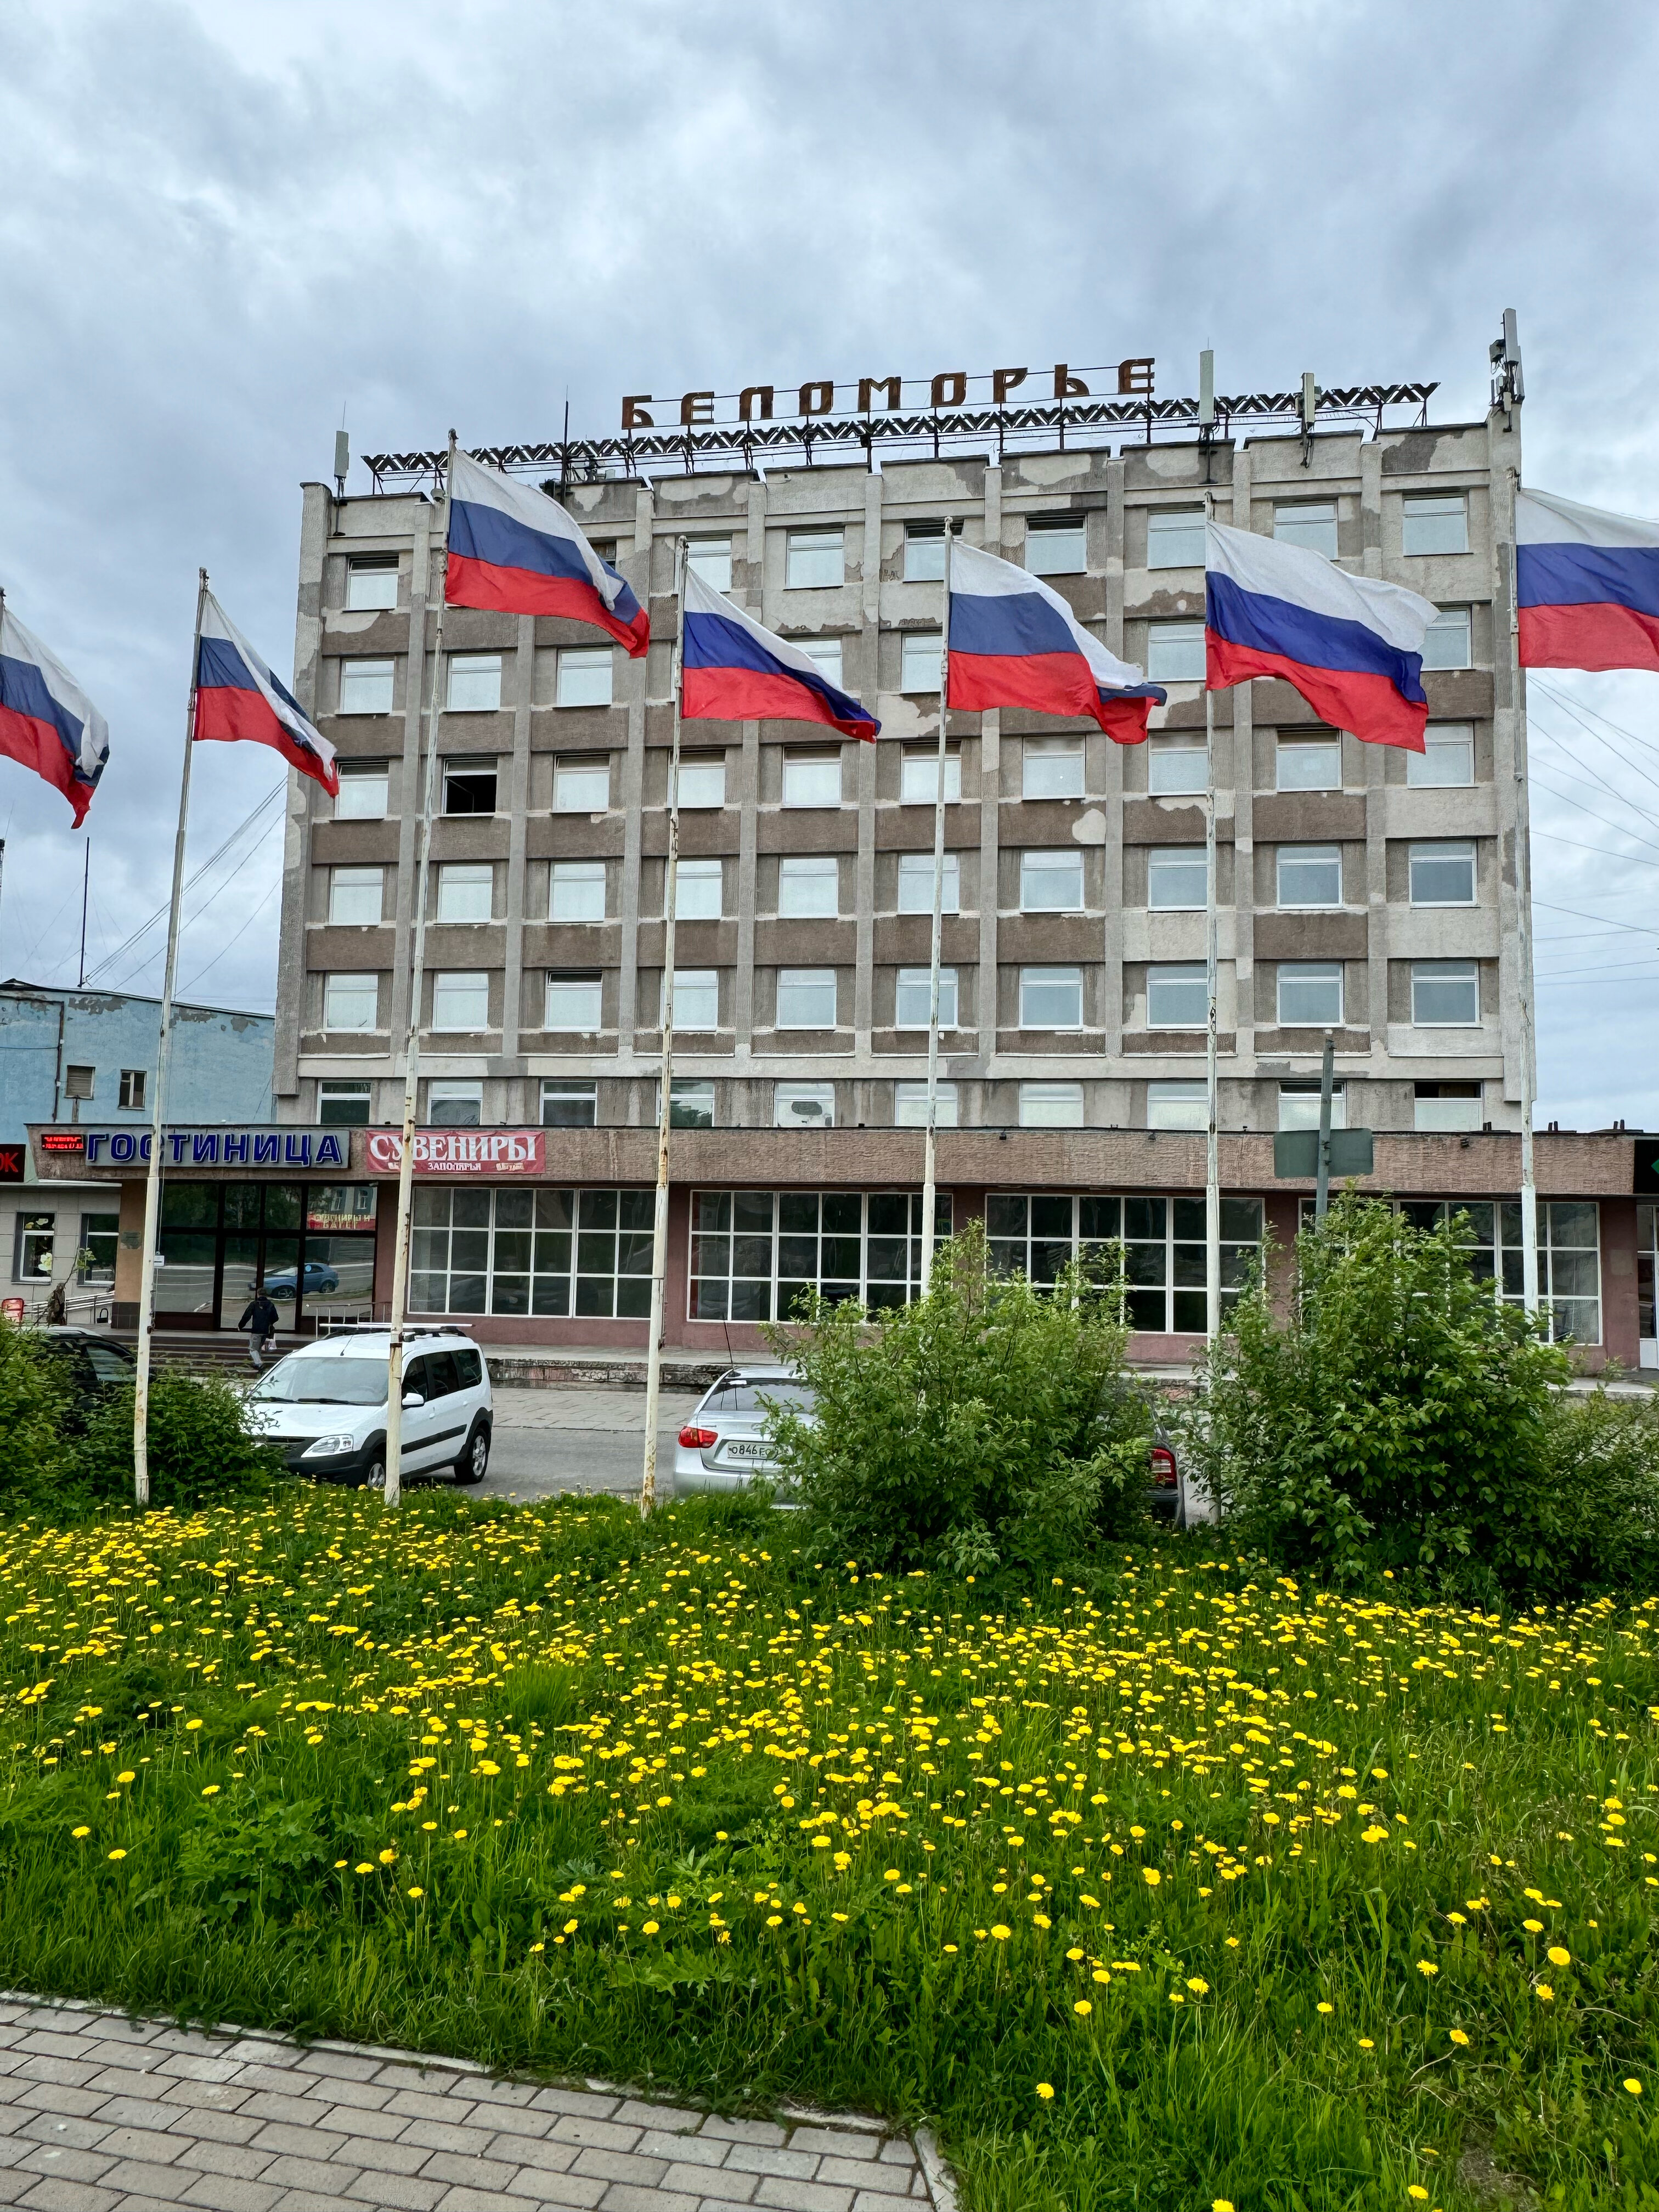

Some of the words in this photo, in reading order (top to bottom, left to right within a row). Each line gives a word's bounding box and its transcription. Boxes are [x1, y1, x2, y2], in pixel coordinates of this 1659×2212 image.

[622, 358, 1155, 430] БЕЛОМОРЬЕ
[87, 1133, 342, 1167] ГОСТИНИЦА
[370, 1135, 537, 1161] СУВЕНИРЫ
